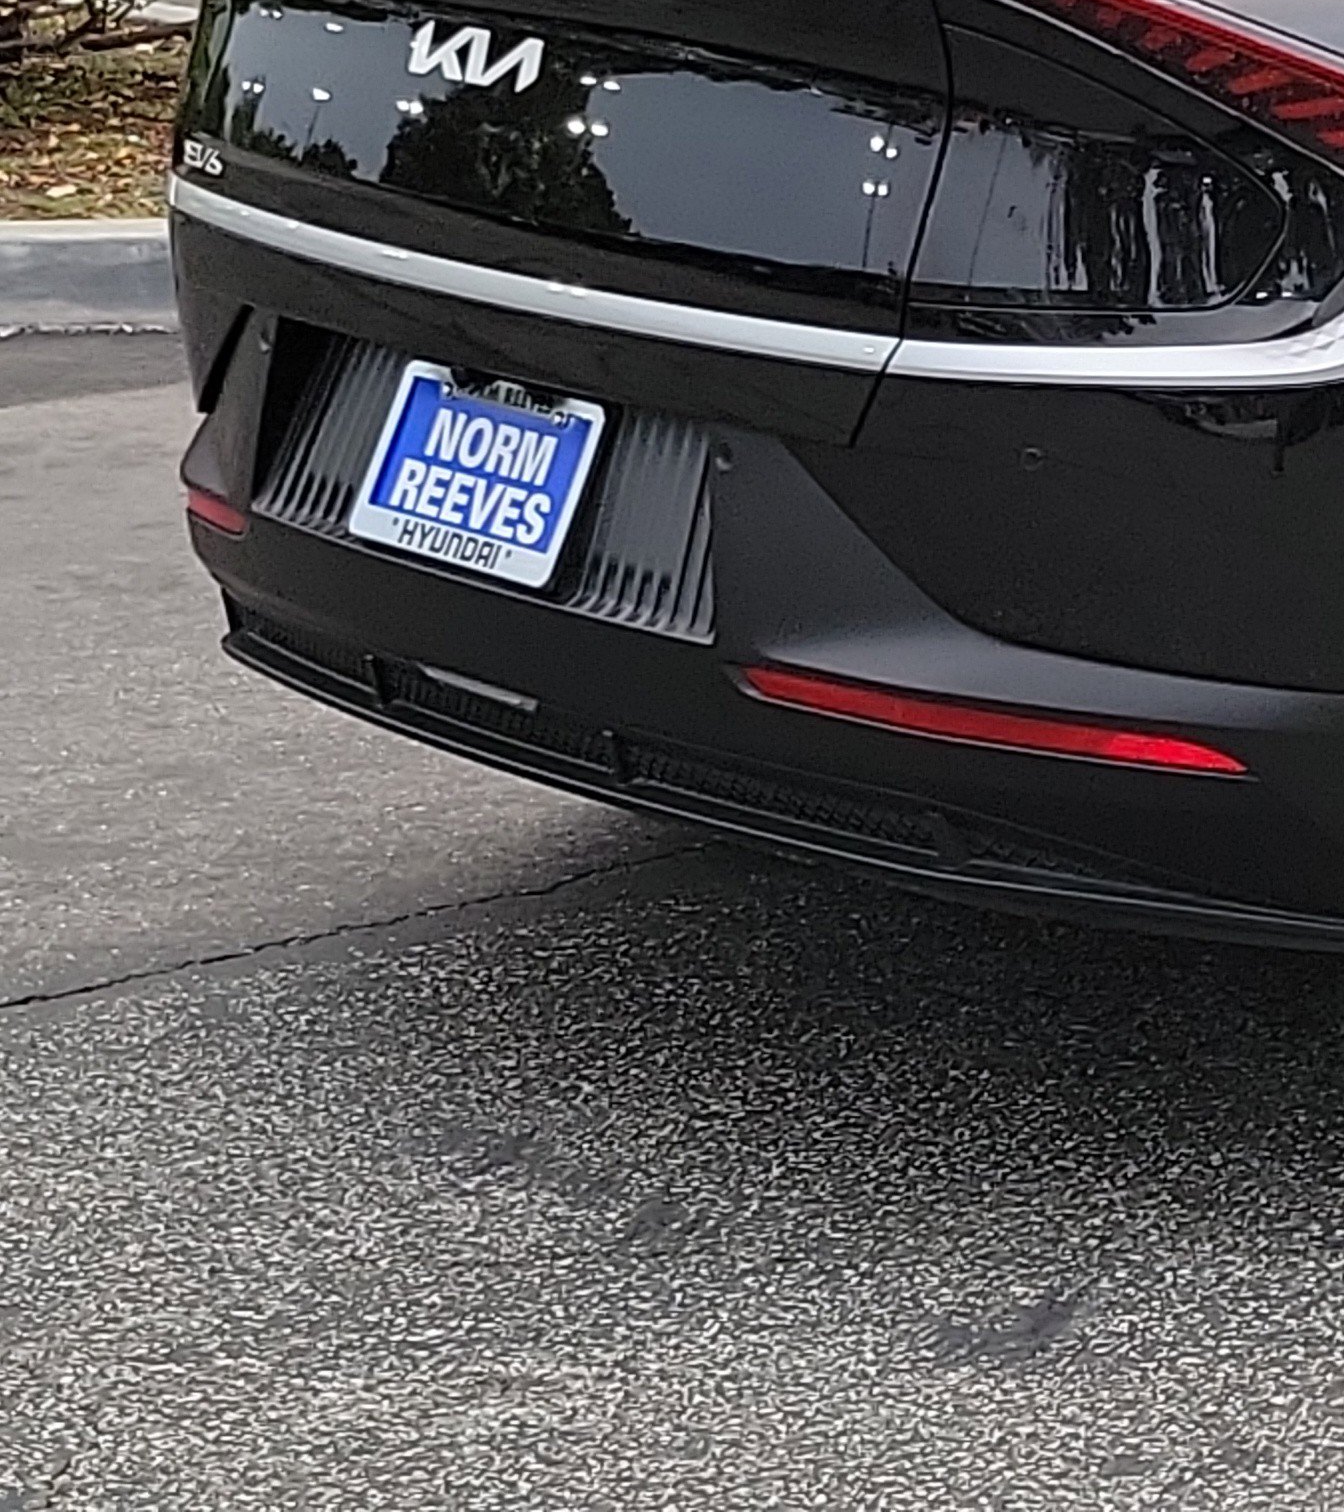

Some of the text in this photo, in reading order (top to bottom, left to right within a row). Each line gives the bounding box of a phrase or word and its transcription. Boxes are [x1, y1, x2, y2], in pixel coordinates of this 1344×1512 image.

[184, 139, 223, 176] EV6
[424, 407, 559, 487] NORM
[388, 457, 552, 545] REEVES
[398, 519, 503, 569] HYUNDAI
